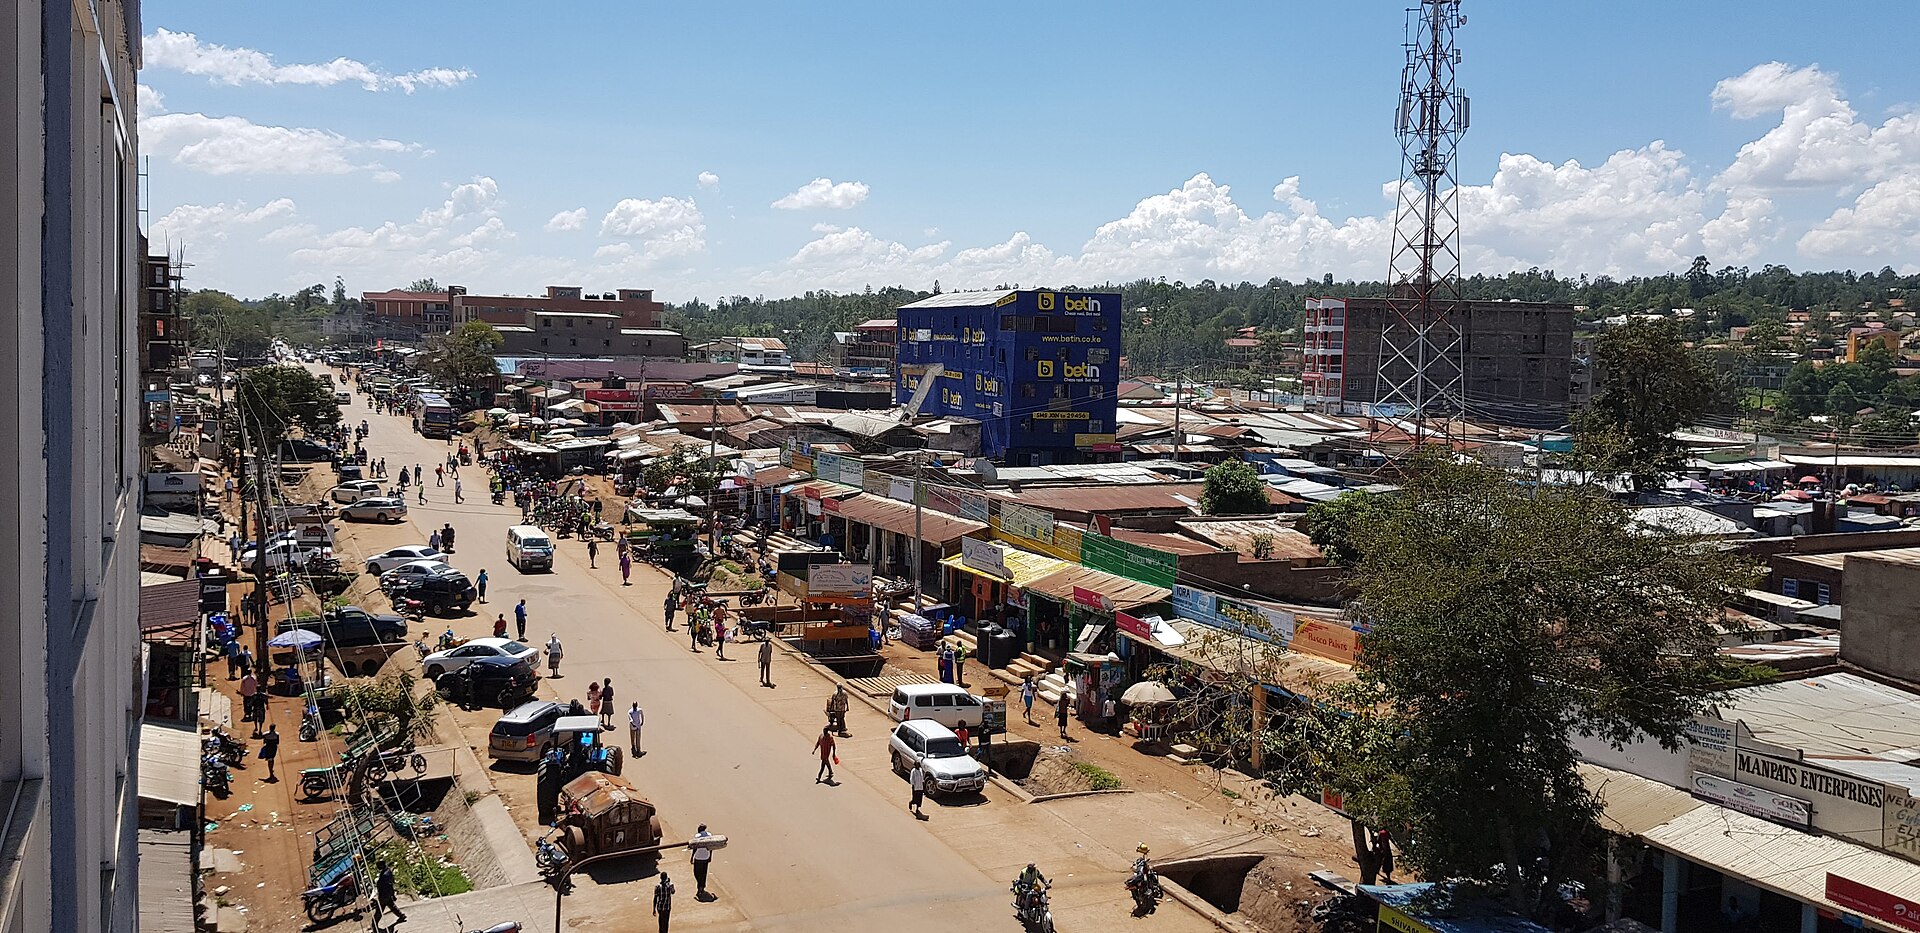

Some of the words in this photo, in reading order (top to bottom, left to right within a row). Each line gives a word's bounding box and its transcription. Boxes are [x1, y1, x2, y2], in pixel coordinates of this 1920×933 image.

[1064, 295, 1101, 311] betin
[972, 328, 986, 343] betin
[1041, 334, 1101, 343] www.betin.co.ke
[1063, 361, 1100, 378] betin
[984, 377, 998, 392] betin
[950, 391, 963, 406] betin
[1738, 753, 1797, 786] MANPATS
[1800, 769, 1883, 809] ENTERPRISES
[1708, 792, 1727, 800] YOUR
[1728, 797, 1781, 817] SUBSCRIPTIONS
[1886, 794, 1916, 810] NEW
